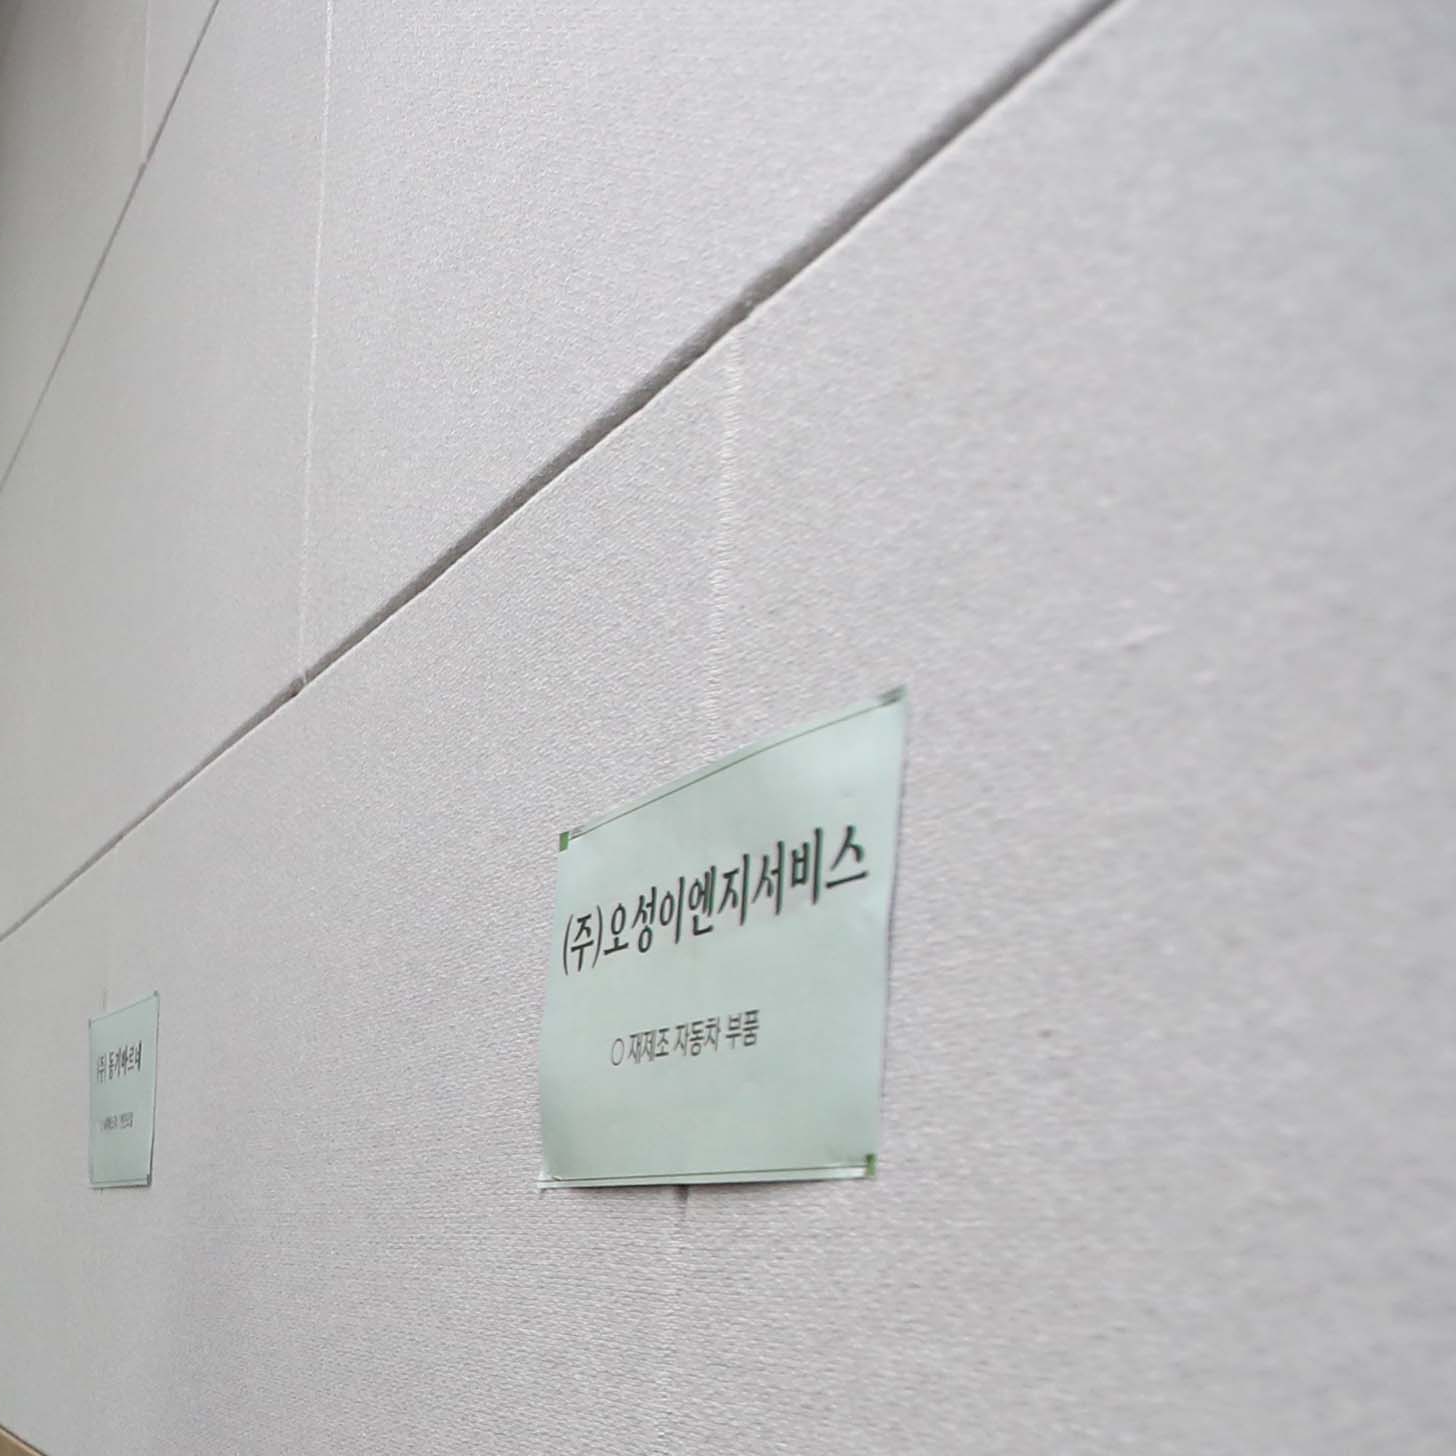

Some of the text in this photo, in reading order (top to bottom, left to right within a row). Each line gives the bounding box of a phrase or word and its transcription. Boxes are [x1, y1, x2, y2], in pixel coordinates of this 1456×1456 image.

[562, 825, 869, 976] (주)오성이엔지서비스
[673, 1016, 721, 1061] 자동차
[725, 1008, 761, 1050] 부품
